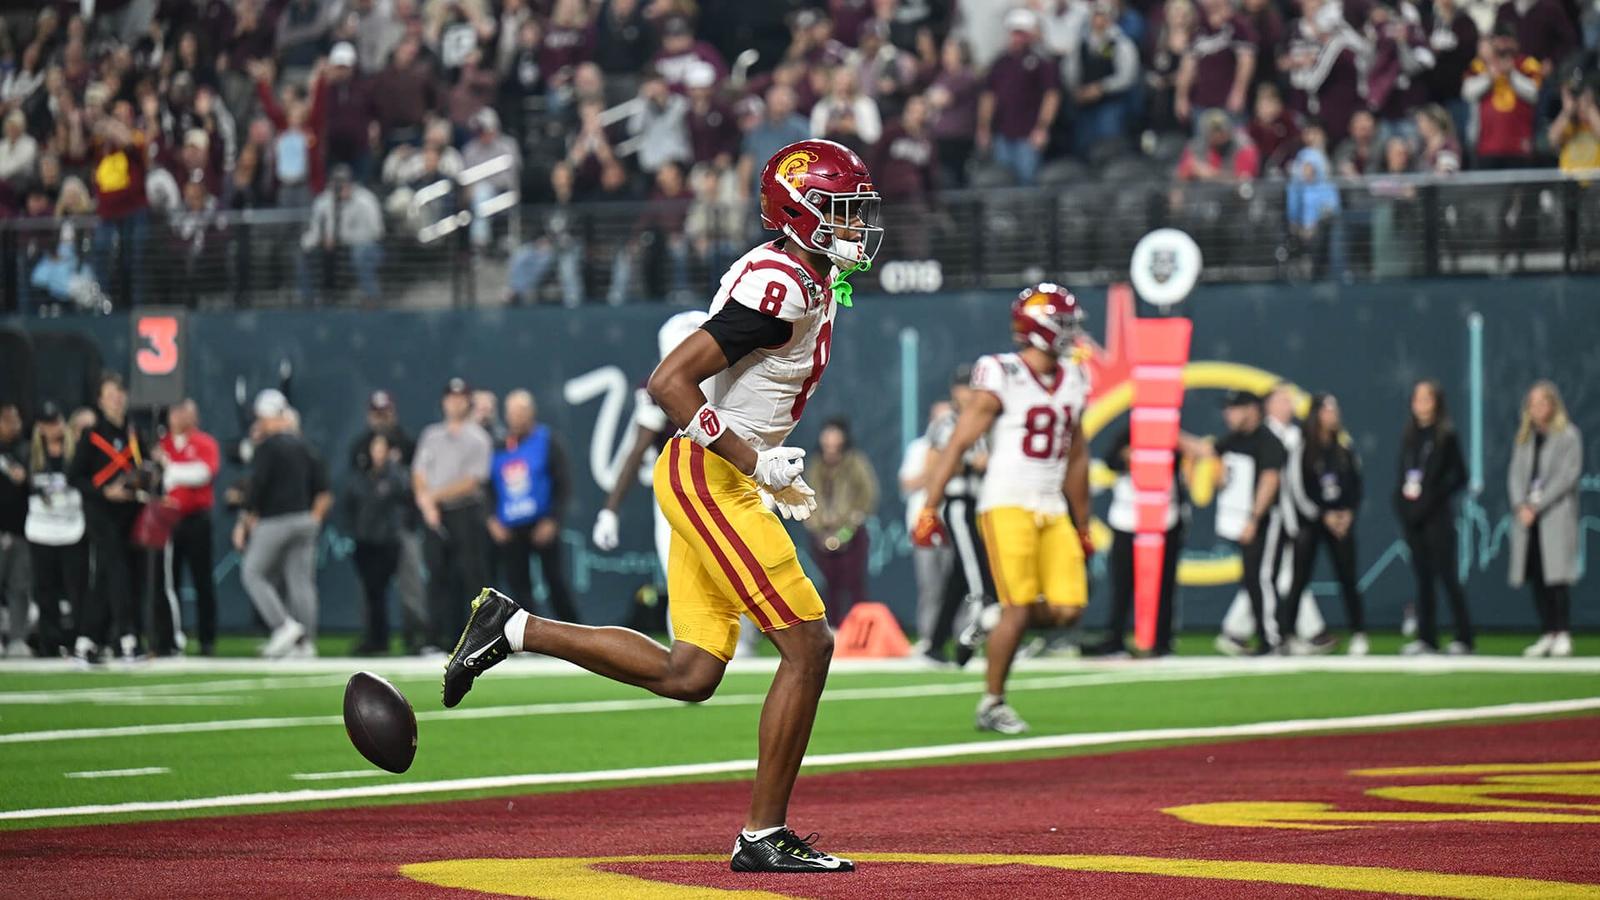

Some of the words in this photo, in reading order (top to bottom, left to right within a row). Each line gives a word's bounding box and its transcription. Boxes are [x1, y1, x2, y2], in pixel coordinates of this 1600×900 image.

[759, 281, 787, 317] 8
[136, 316, 178, 375] 3
[791, 320, 832, 421] 8
[1022, 404, 1072, 460] 81
